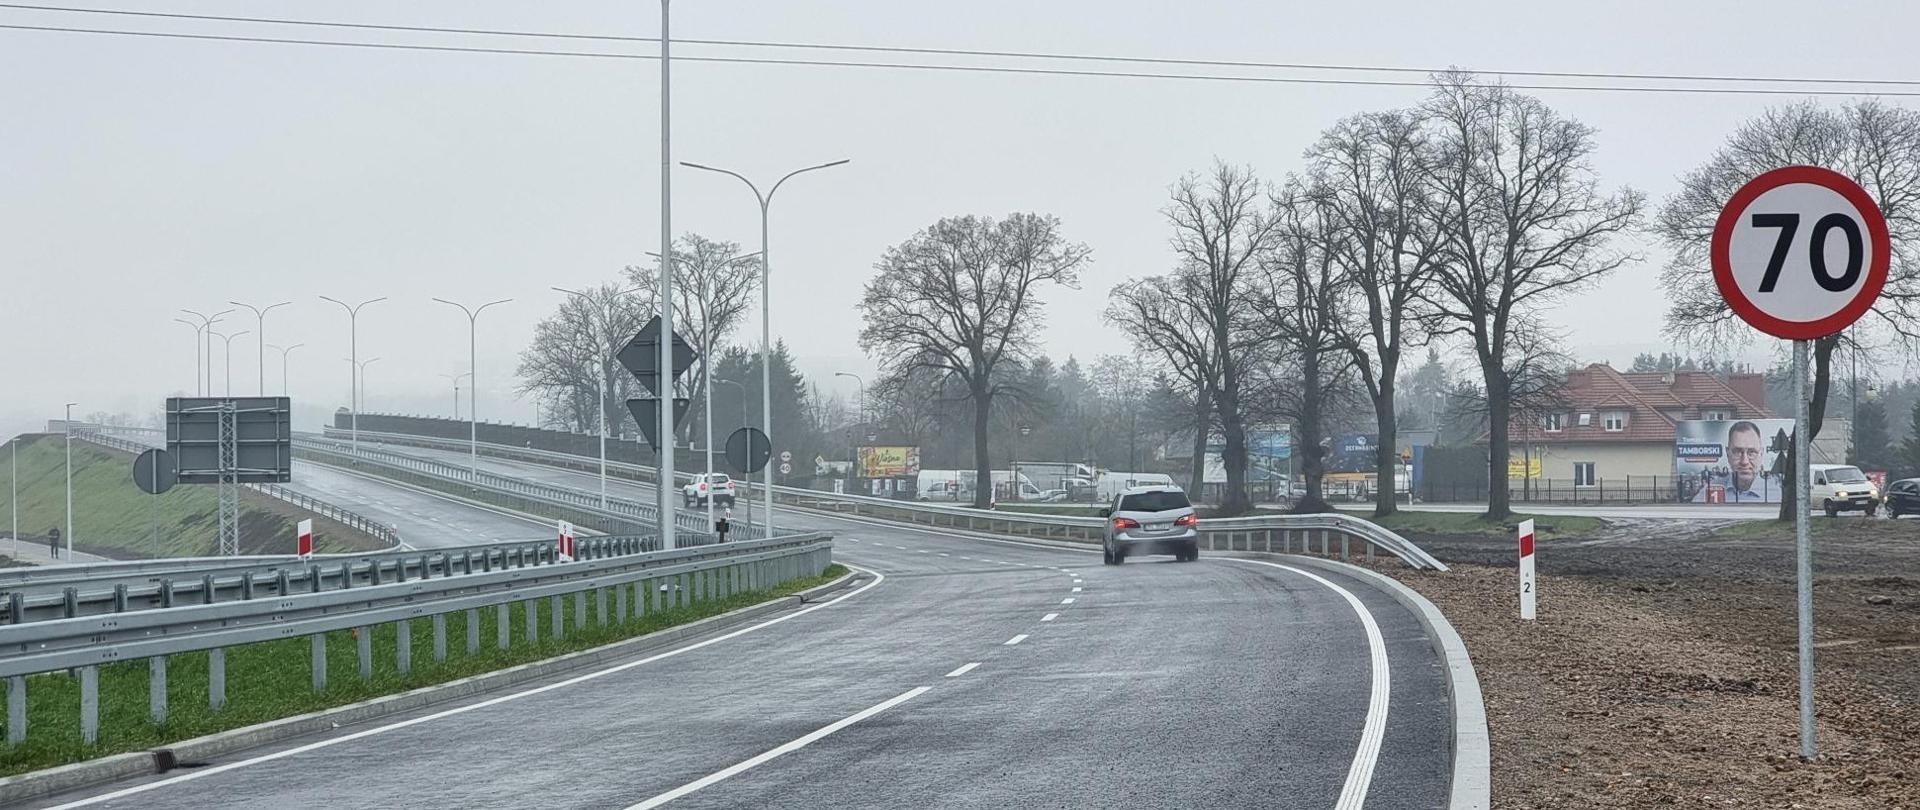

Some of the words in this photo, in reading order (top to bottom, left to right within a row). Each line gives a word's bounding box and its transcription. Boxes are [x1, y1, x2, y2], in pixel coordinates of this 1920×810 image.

[1752, 213, 1864, 292] 70
[1678, 447, 1720, 455] TAMBORSKI
[1711, 491, 1718, 503] 1
[1523, 581, 1531, 593] 2
